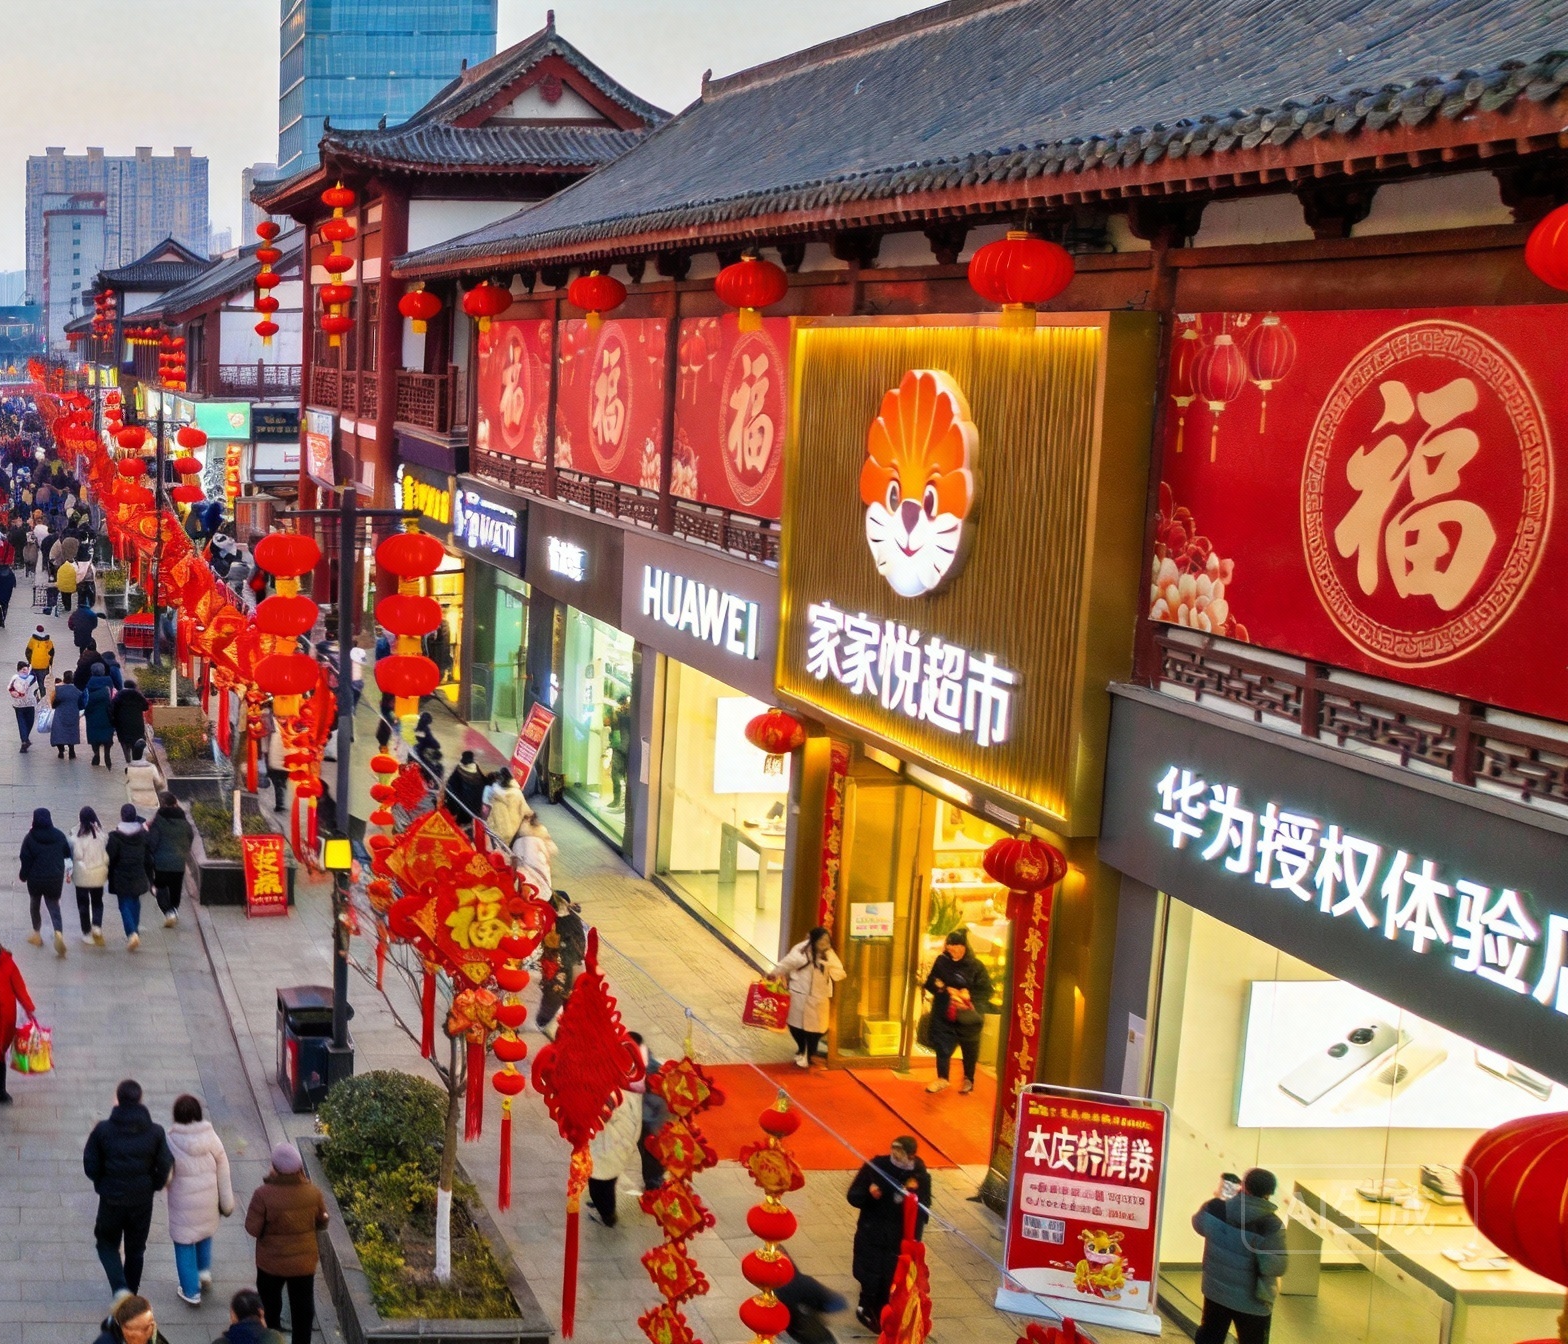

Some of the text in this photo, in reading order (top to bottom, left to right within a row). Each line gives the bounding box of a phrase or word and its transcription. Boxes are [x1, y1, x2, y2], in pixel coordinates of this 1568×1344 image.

[592, 346, 625, 446] 福
[728, 352, 774, 473] 福
[1334, 377, 1497, 611] 福
[642, 564, 760, 660] HUAWEI
[805, 601, 1016, 747] 家家悦超市
